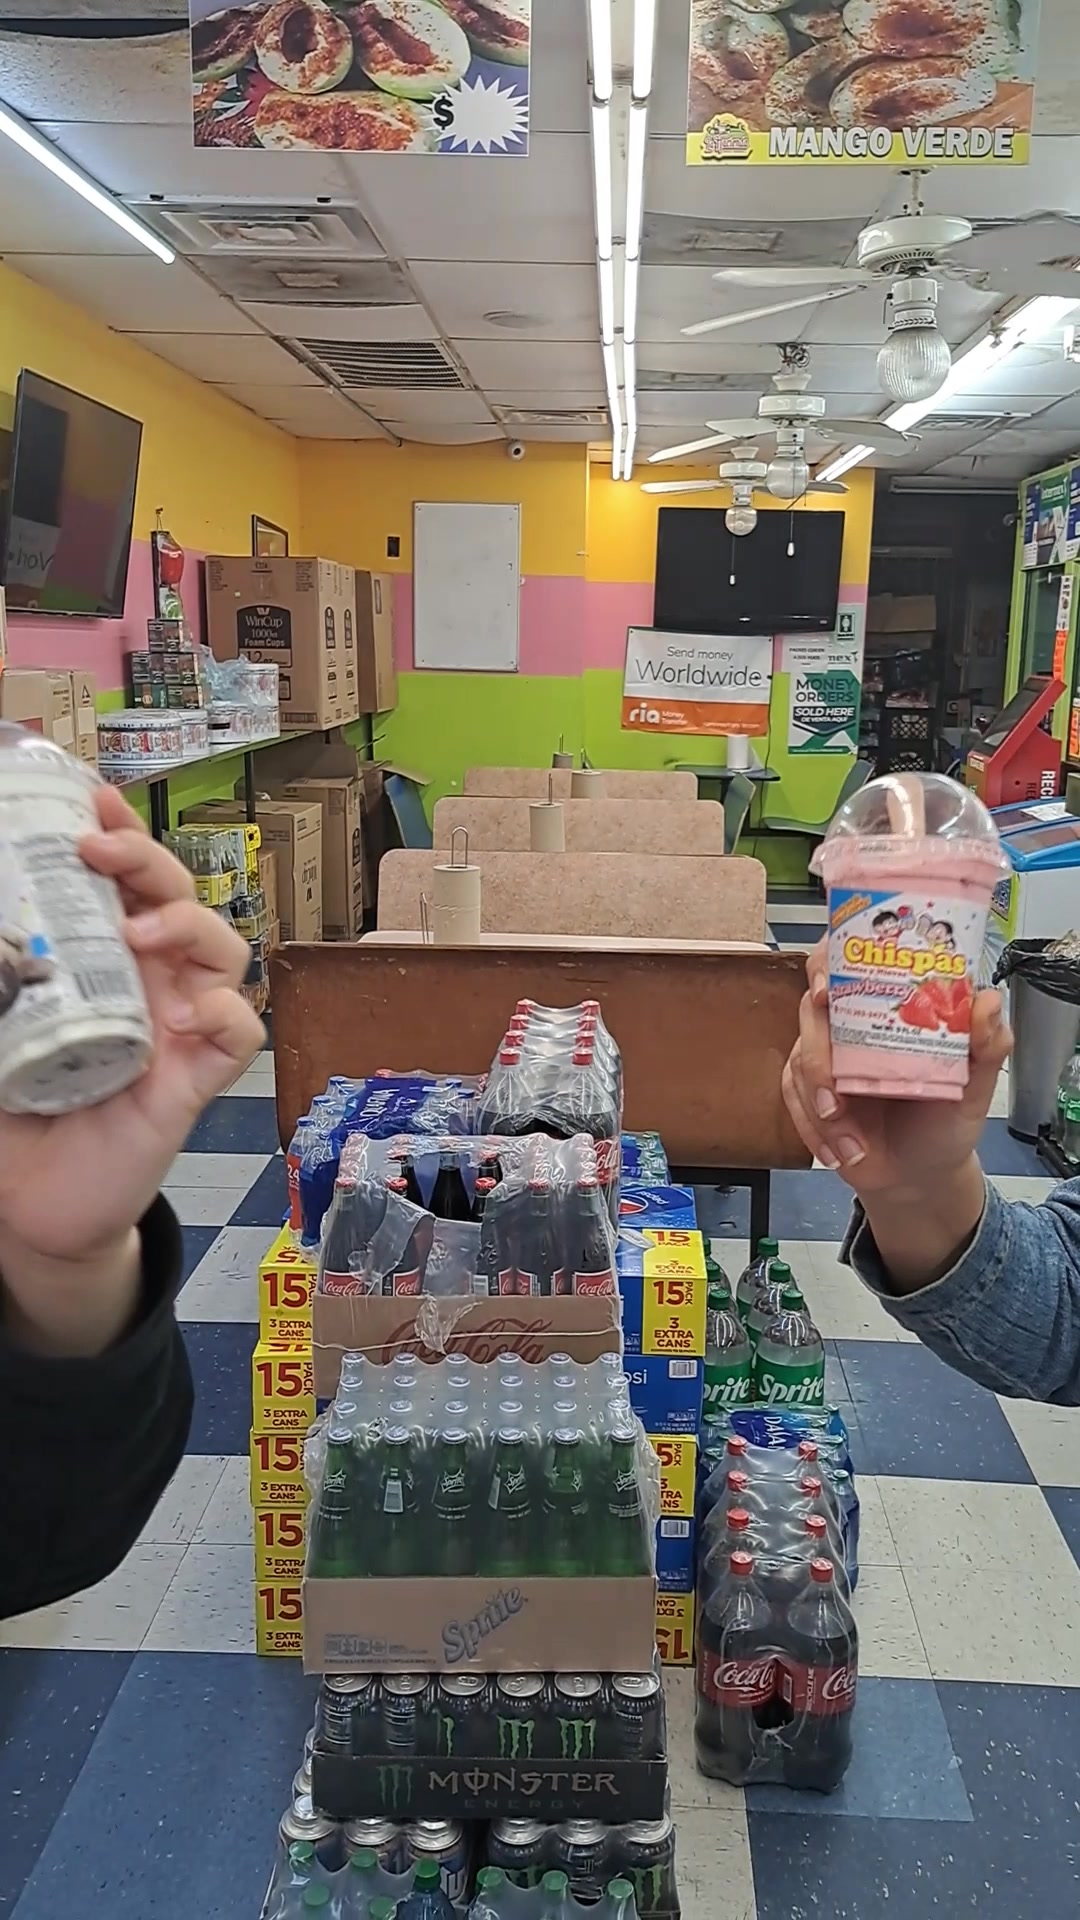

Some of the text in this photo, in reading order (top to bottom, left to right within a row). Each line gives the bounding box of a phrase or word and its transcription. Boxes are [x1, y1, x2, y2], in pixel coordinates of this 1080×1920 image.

[431, 93, 454, 132] $
[769, 127, 893, 157] MANGO
[902, 127, 1016, 157] VERDE
[245, 615, 283, 628] WinCup
[244, 638, 285, 647] Foam Cups
[667, 646, 733, 661] Send money
[635, 659, 762, 687] Worldwide
[796, 679, 855, 691] MONEY
[796, 692, 854, 703] ORDERS
[629, 702, 660, 724] ria
[795, 707, 855, 717] SOLD HERE
[843, 936, 966, 976] Chispas
[652, 1231, 690, 1243] 15
[263, 1273, 308, 1308] 15
[653, 1280, 693, 1306] 15 PACK
[269, 1318, 313, 1329] 3 EXTRA
[669, 1317, 680, 1329] 3
[278, 1329, 305, 1337] CANS
[654, 1330, 694, 1339] EXTRA
[657, 1339, 691, 1348] CANS
[256, 1361, 314, 1397] 15 PACK
[703, 1374, 750, 1402] prite
[759, 1373, 824, 1406] Sprite
[263, 1409, 308, 1418] 3 EXTRA
[272, 1418, 300, 1427] CANS
[253, 1436, 299, 1472] 15
[657, 1443, 682, 1467] 5 PACK
[260, 1482, 304, 1492] 3 EXTRA
[269, 1492, 296, 1500] CANS
[660, 1490, 683, 1499] TRA
[660, 1499, 680, 1508] ANS
[258, 1512, 303, 1547] 15
[265, 1557, 305, 1567] 3 EXTRA
[273, 1567, 300, 1575] CANS
[259, 1587, 303, 1621] 15
[441, 1586, 524, 1664] Sprite
[266, 1632, 273, 1641] 3
[428, 1767, 620, 1796] MONSTER
[464, 1800, 583, 1810] ENERGY
